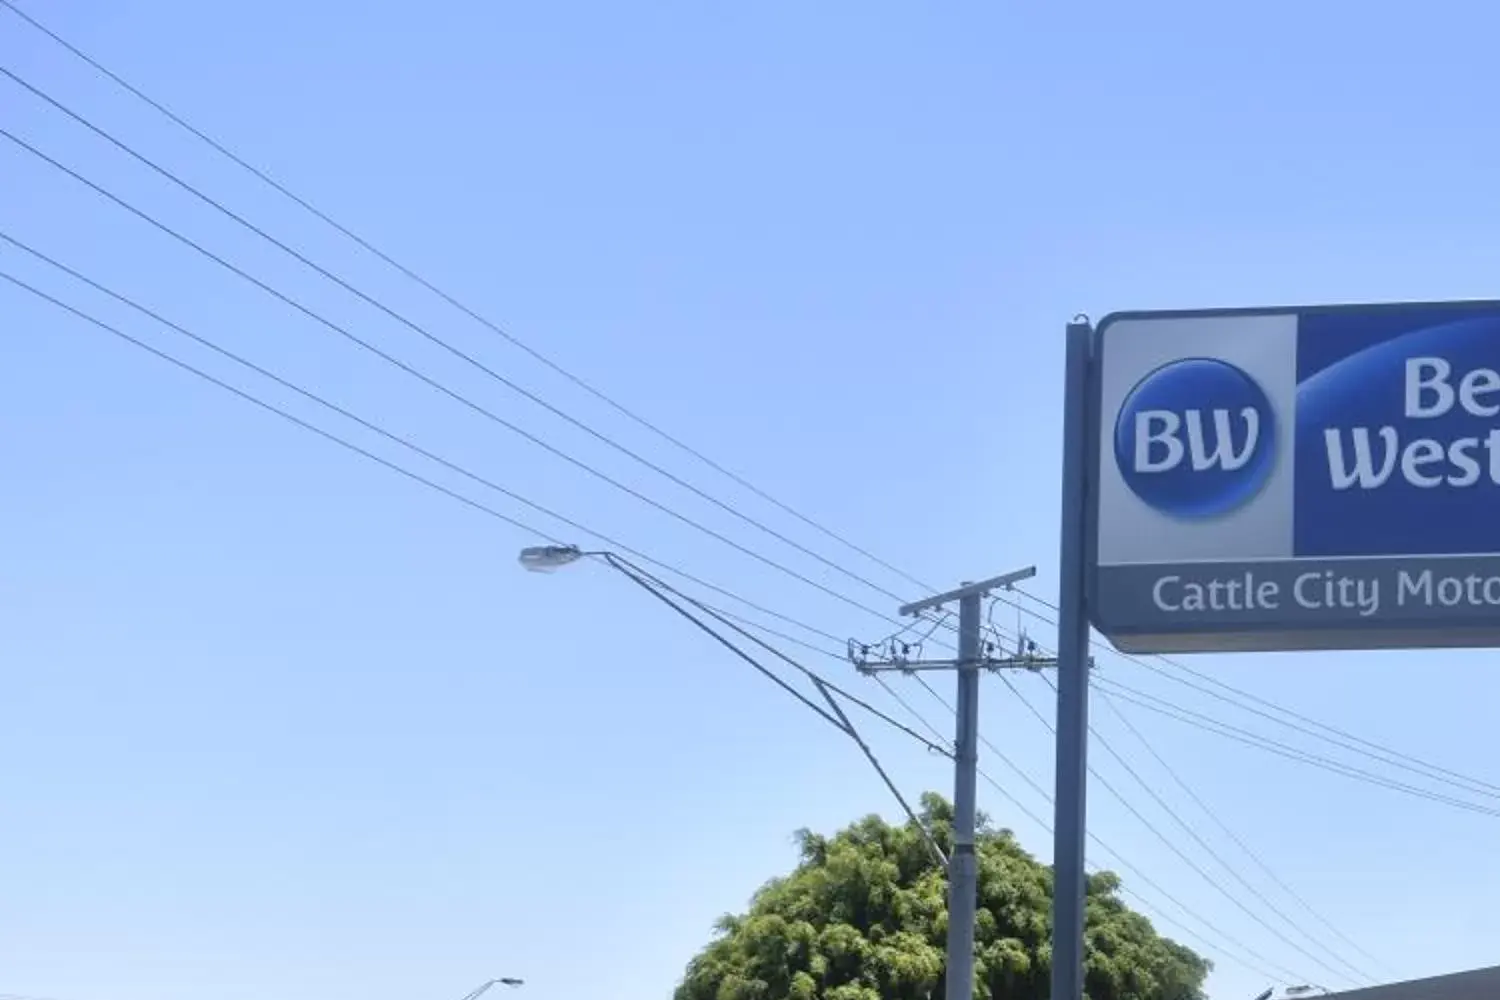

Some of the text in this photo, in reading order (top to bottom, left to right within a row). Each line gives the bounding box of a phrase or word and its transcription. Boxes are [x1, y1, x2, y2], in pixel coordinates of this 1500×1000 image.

[1134, 406, 1259, 473] BW
[1151, 571, 1280, 612] Cattle
[1292, 570, 1380, 617] City
